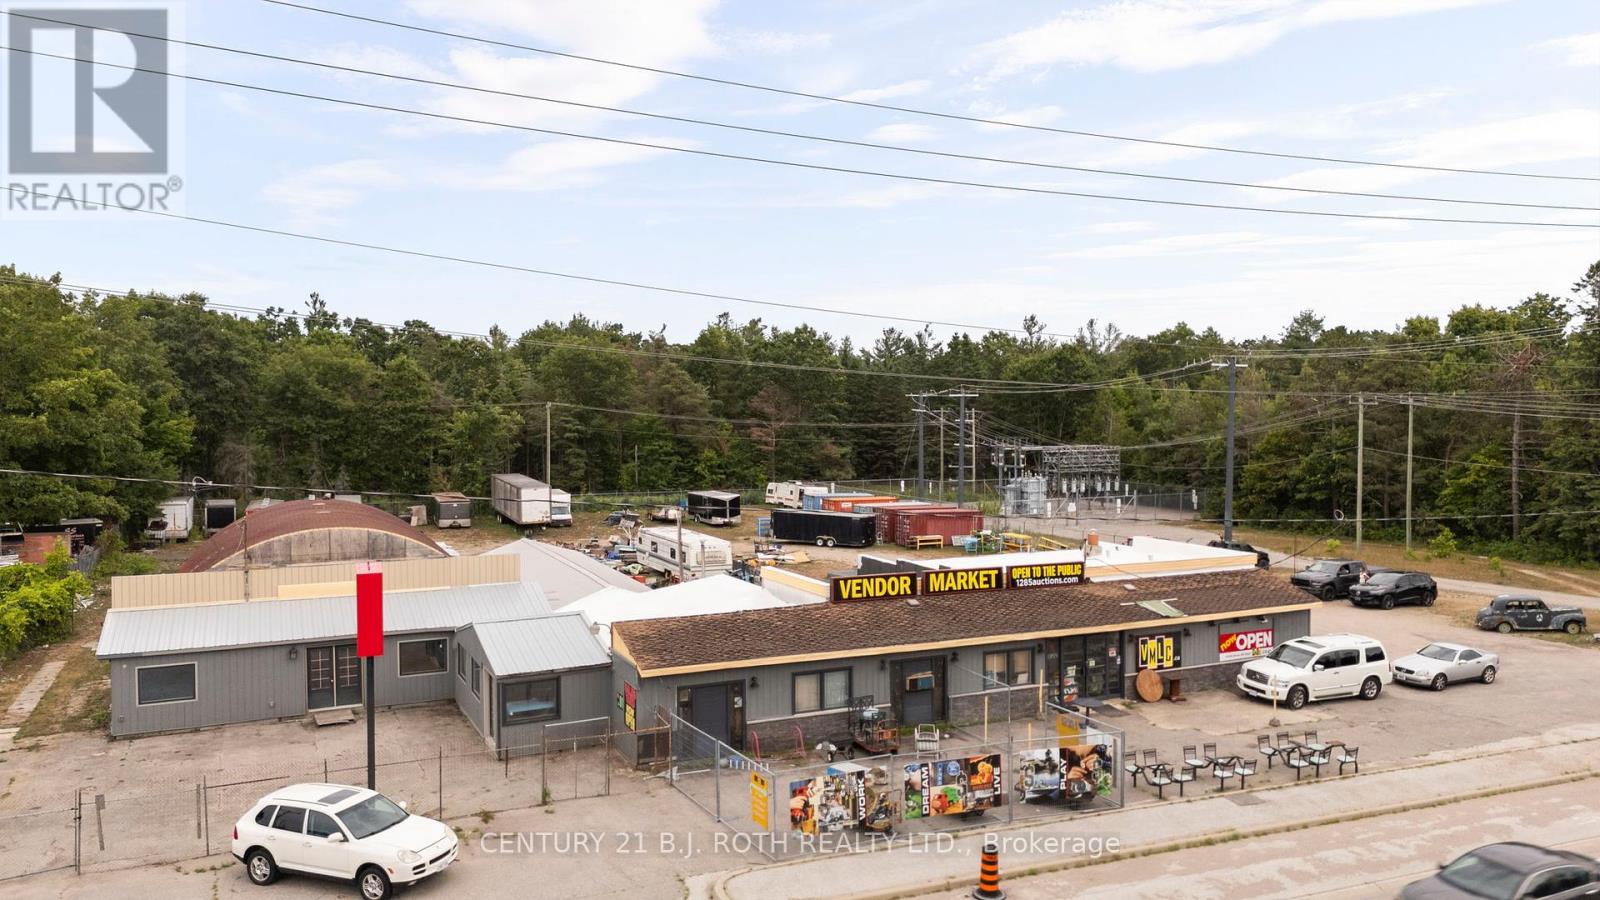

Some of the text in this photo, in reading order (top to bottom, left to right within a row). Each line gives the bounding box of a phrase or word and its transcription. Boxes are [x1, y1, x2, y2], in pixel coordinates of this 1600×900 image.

[839, 569, 999, 599] VENDOR MARKET
[1012, 564, 1082, 579] OPEN TO THE PUBLIC
[1016, 576, 1079, 587] 1285auctions.com
[1236, 630, 1273, 651] OPEN
[993, 767, 1001, 795] LIVE
[1060, 758, 1068, 790] PLAY
[857, 777, 866, 821] WORK
[922, 766, 930, 815] DREAM
